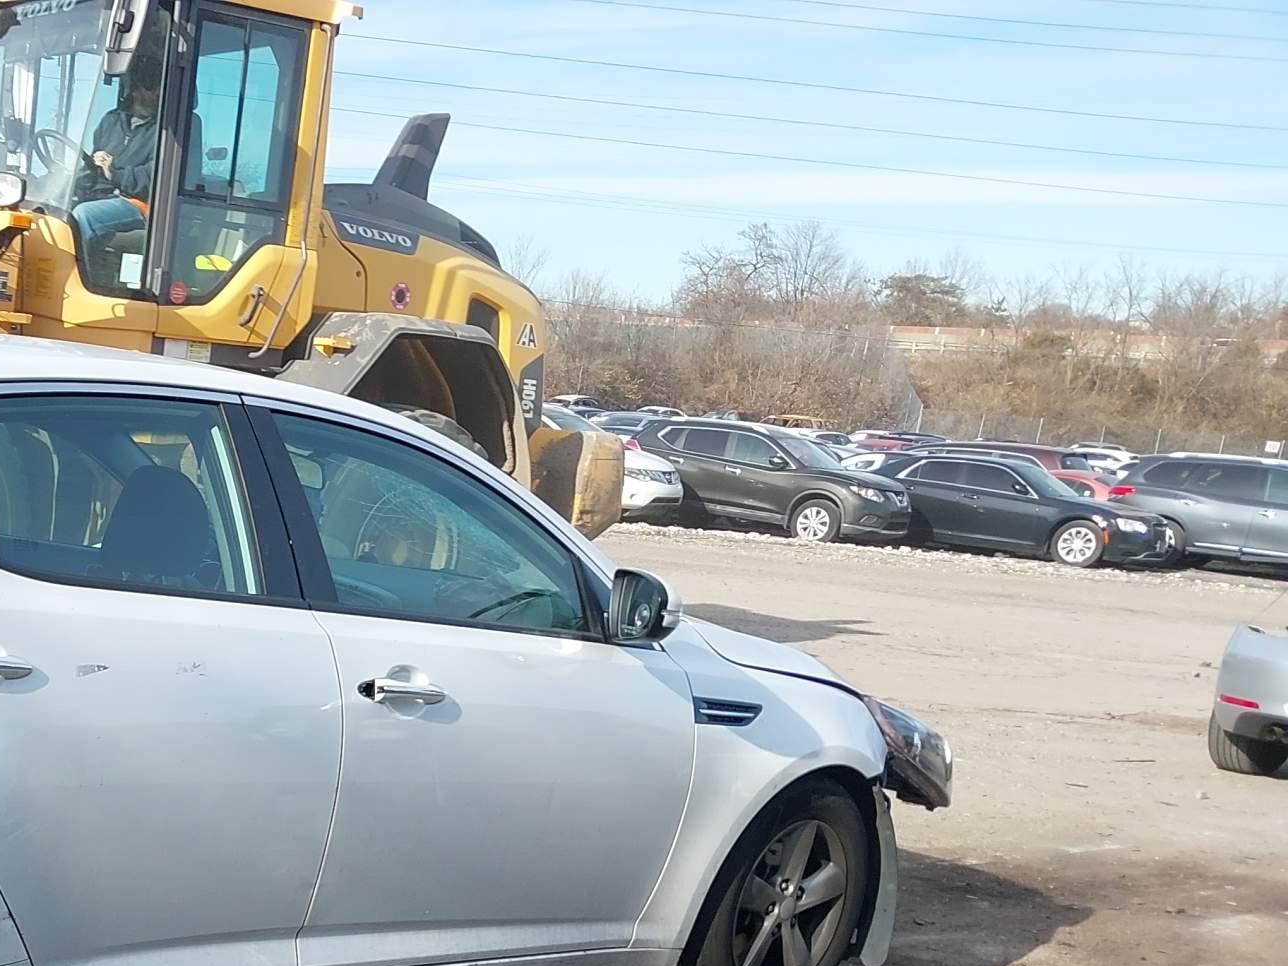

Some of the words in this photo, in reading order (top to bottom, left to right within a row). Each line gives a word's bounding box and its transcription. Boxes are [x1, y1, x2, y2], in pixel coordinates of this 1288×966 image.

[11, 0, 76, 20] VOLVO
[339, 221, 412, 247] VOLVO
[521, 378, 537, 418] L90H
